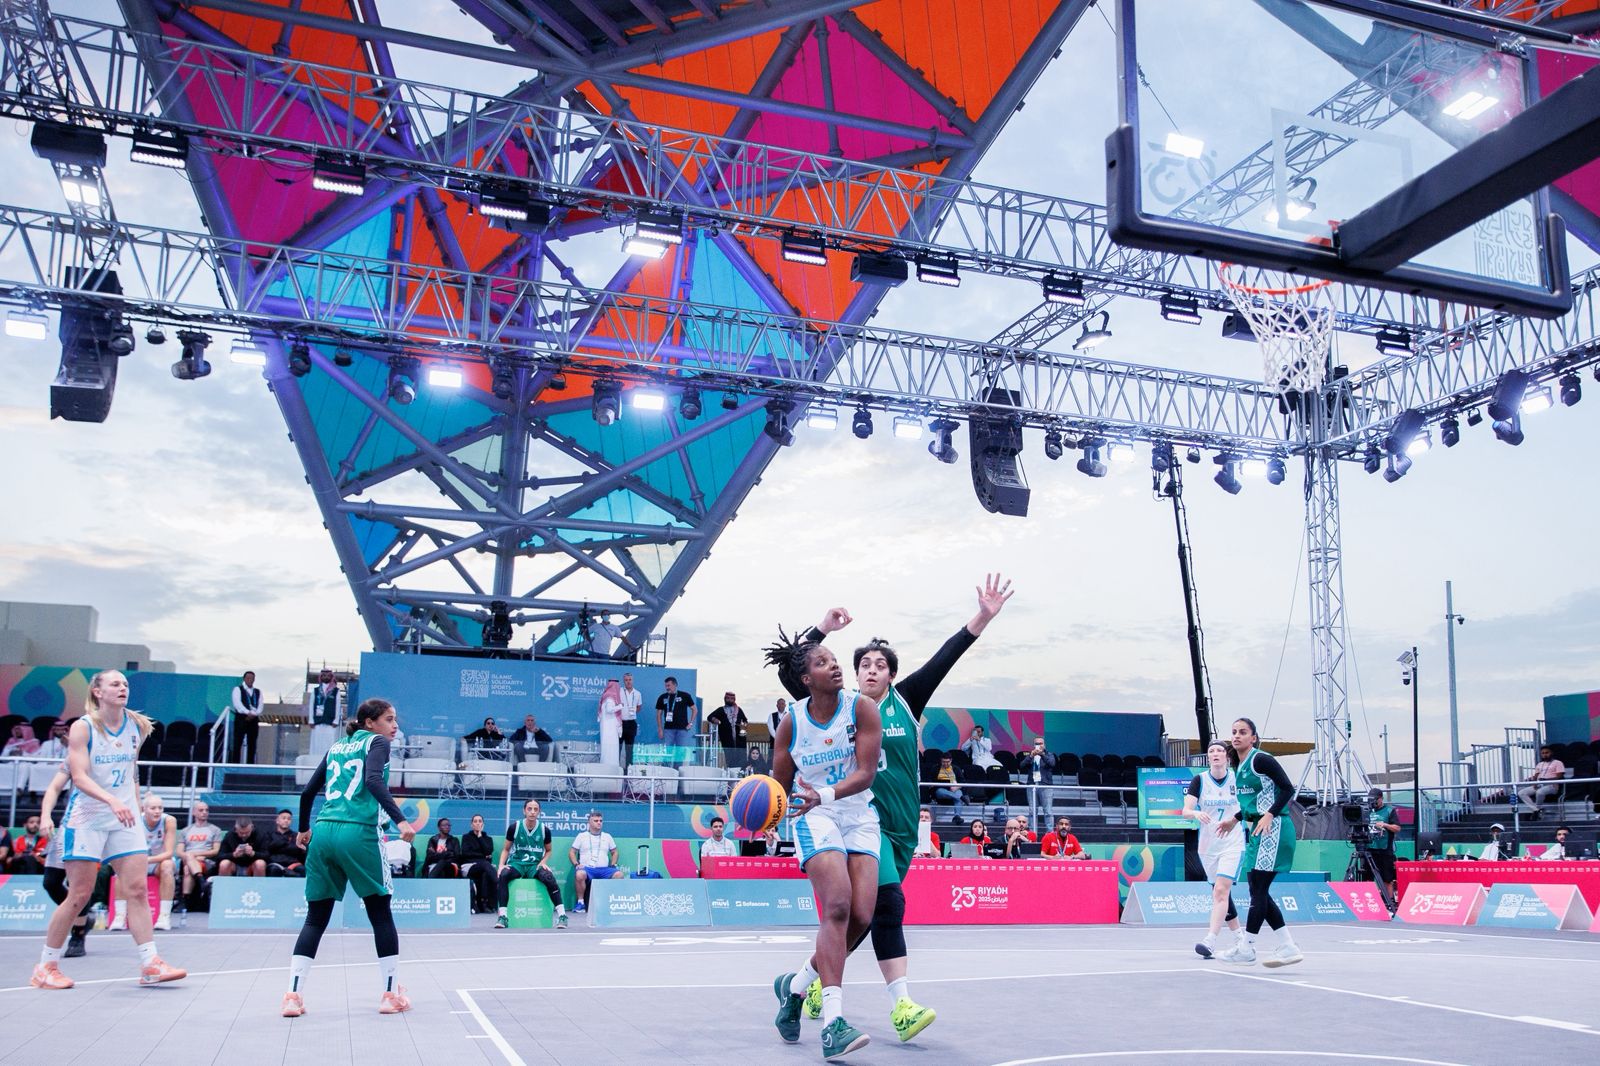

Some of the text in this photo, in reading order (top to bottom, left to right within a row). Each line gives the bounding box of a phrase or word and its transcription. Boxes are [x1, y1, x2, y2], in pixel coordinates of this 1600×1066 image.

[572, 676, 607, 688] RIYADH
[882, 723, 906, 737] rabia
[325, 758, 364, 801] 27
[825, 763, 847, 786] 34
[1217, 808, 1225, 821] 7
[978, 886, 1009, 896] RIYADH
